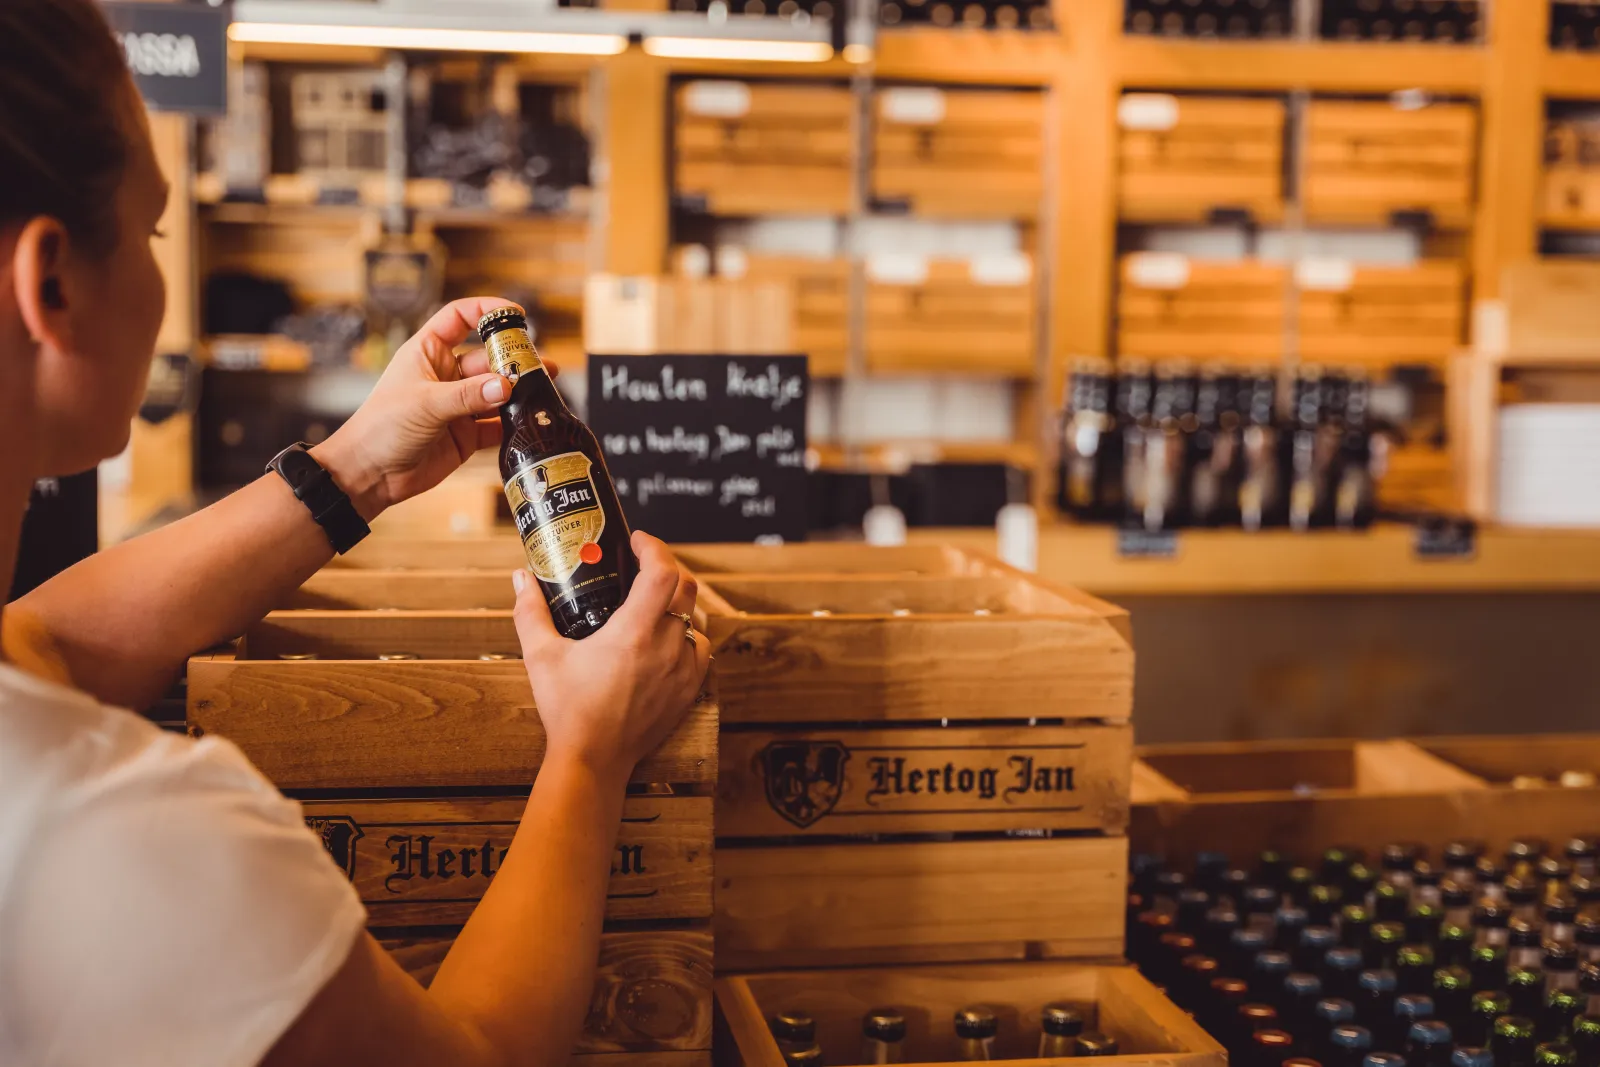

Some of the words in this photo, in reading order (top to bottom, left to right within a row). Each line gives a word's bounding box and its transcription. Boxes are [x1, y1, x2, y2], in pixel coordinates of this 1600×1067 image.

[118, 32, 200, 77] ASSA
[553, 487, 592, 513] Jan
[529, 520, 582, 553] NATUURZUIVER
[544, 535, 562, 549] BIER
[866, 756, 998, 806] Hertog
[1003, 755, 1076, 804] Jan
[384, 834, 510, 893] Hert
